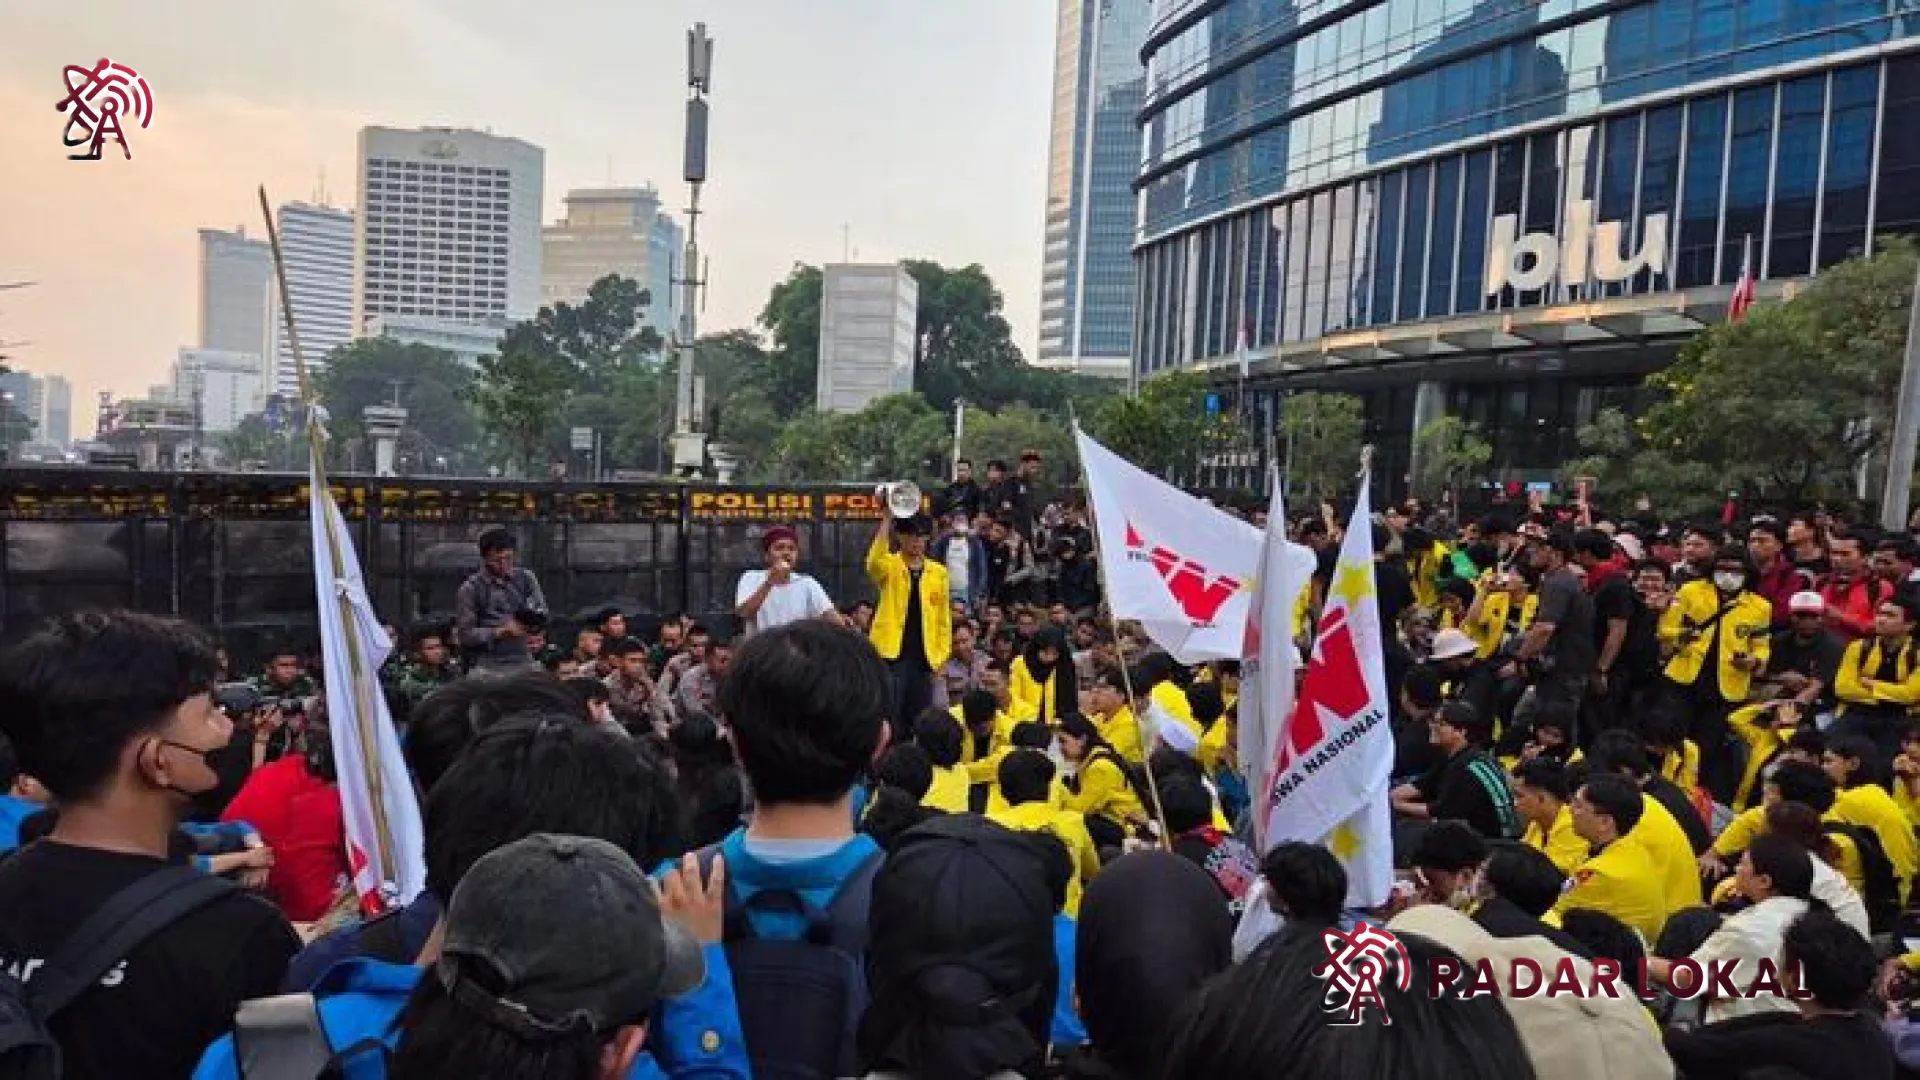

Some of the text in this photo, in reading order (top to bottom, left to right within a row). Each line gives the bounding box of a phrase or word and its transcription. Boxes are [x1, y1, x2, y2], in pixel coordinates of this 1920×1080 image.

[1487, 198, 1668, 295] blu
[691, 492, 813, 510] POLISI
[823, 493, 931, 511] POLI
[1302, 708, 1384, 775] NASIONAL
